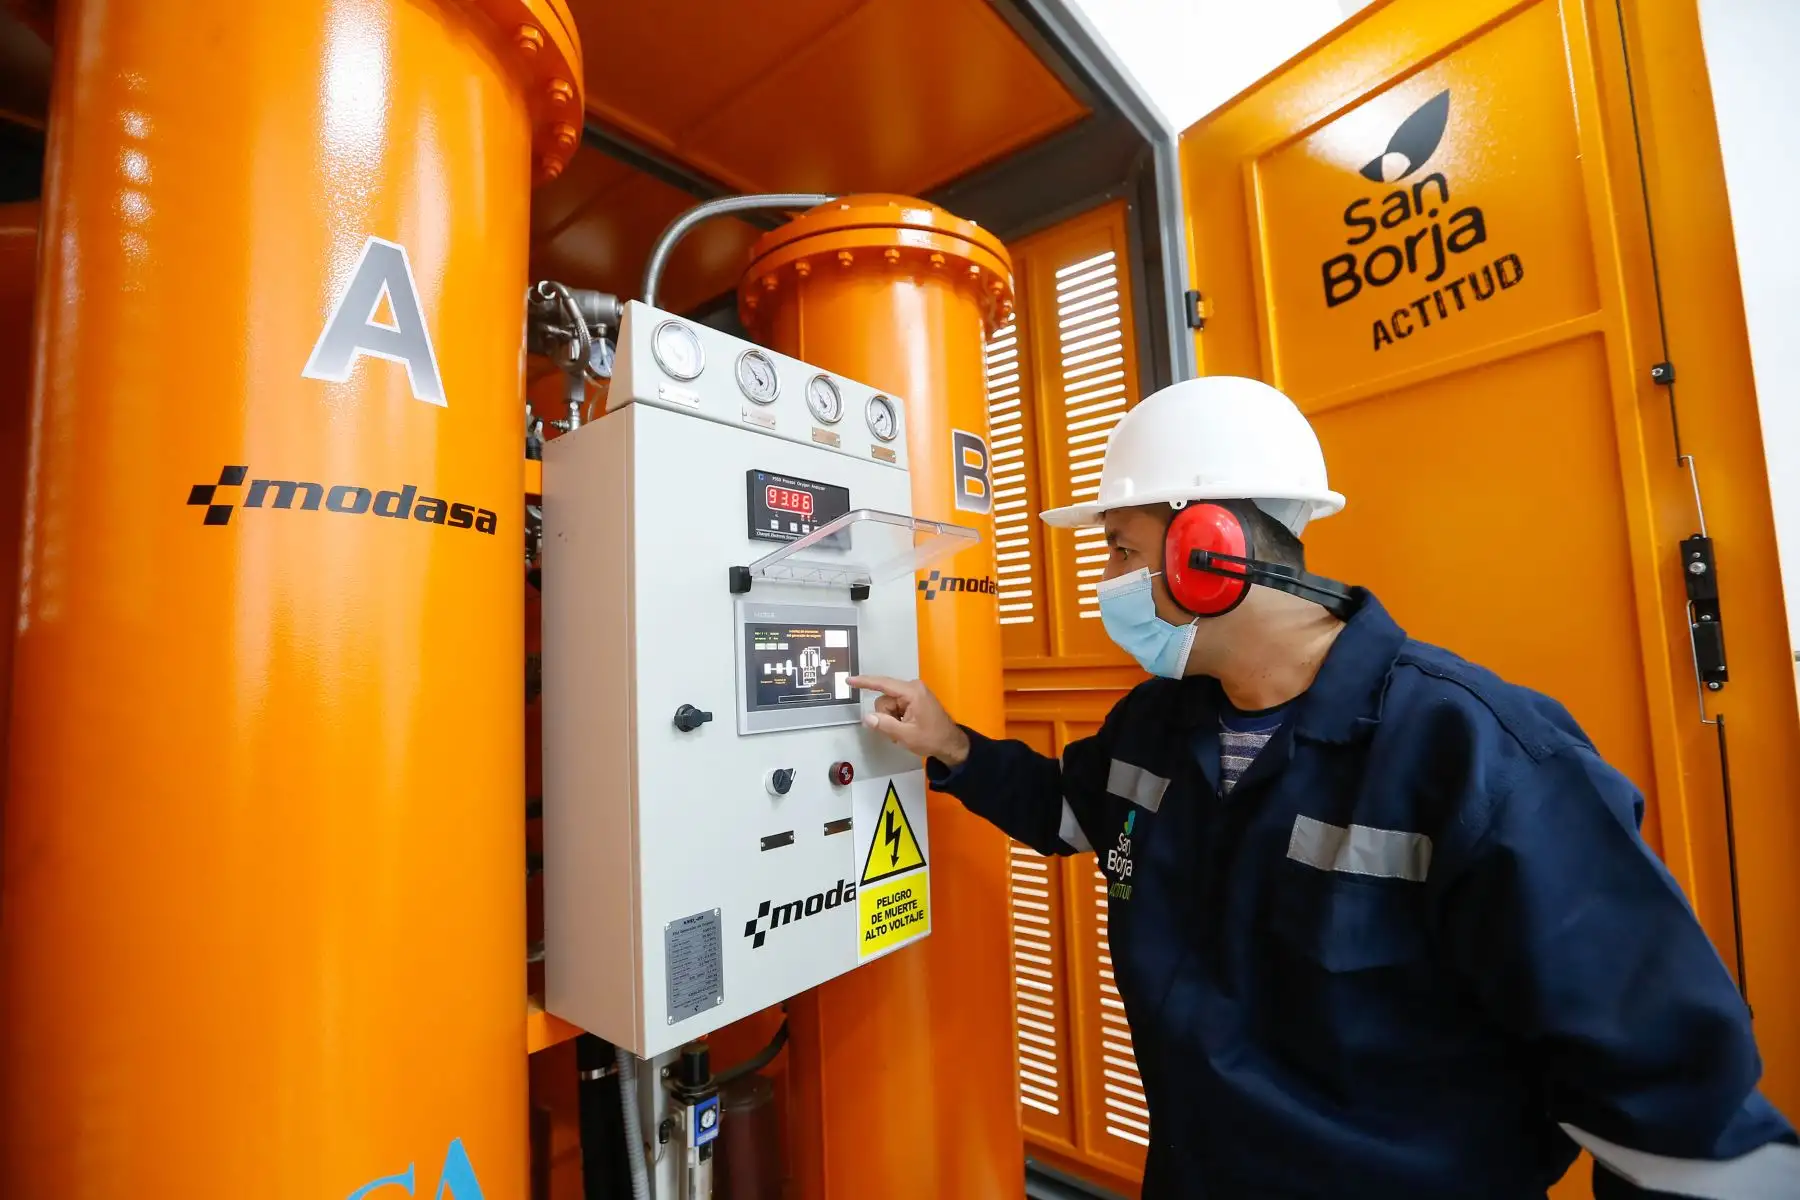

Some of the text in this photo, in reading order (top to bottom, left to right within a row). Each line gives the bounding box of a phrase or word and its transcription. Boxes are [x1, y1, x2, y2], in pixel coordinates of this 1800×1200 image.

[1343, 172, 1449, 245] San
[1321, 206, 1487, 308] Borja
[301, 235, 448, 408] A
[1372, 253, 1524, 351] ACTITUD
[952, 428, 992, 515] B
[243, 479, 498, 535] modasa
[940, 576, 998, 595] moda
[1107, 849, 1133, 881] Borja
[1117, 832, 1131, 857] San
[770, 879, 857, 930] moda
[871, 900, 918, 925] DE MUERTE
[877, 888, 912, 909] PELIGRO
[864, 910, 924, 941] ALTO VOLTAJE
